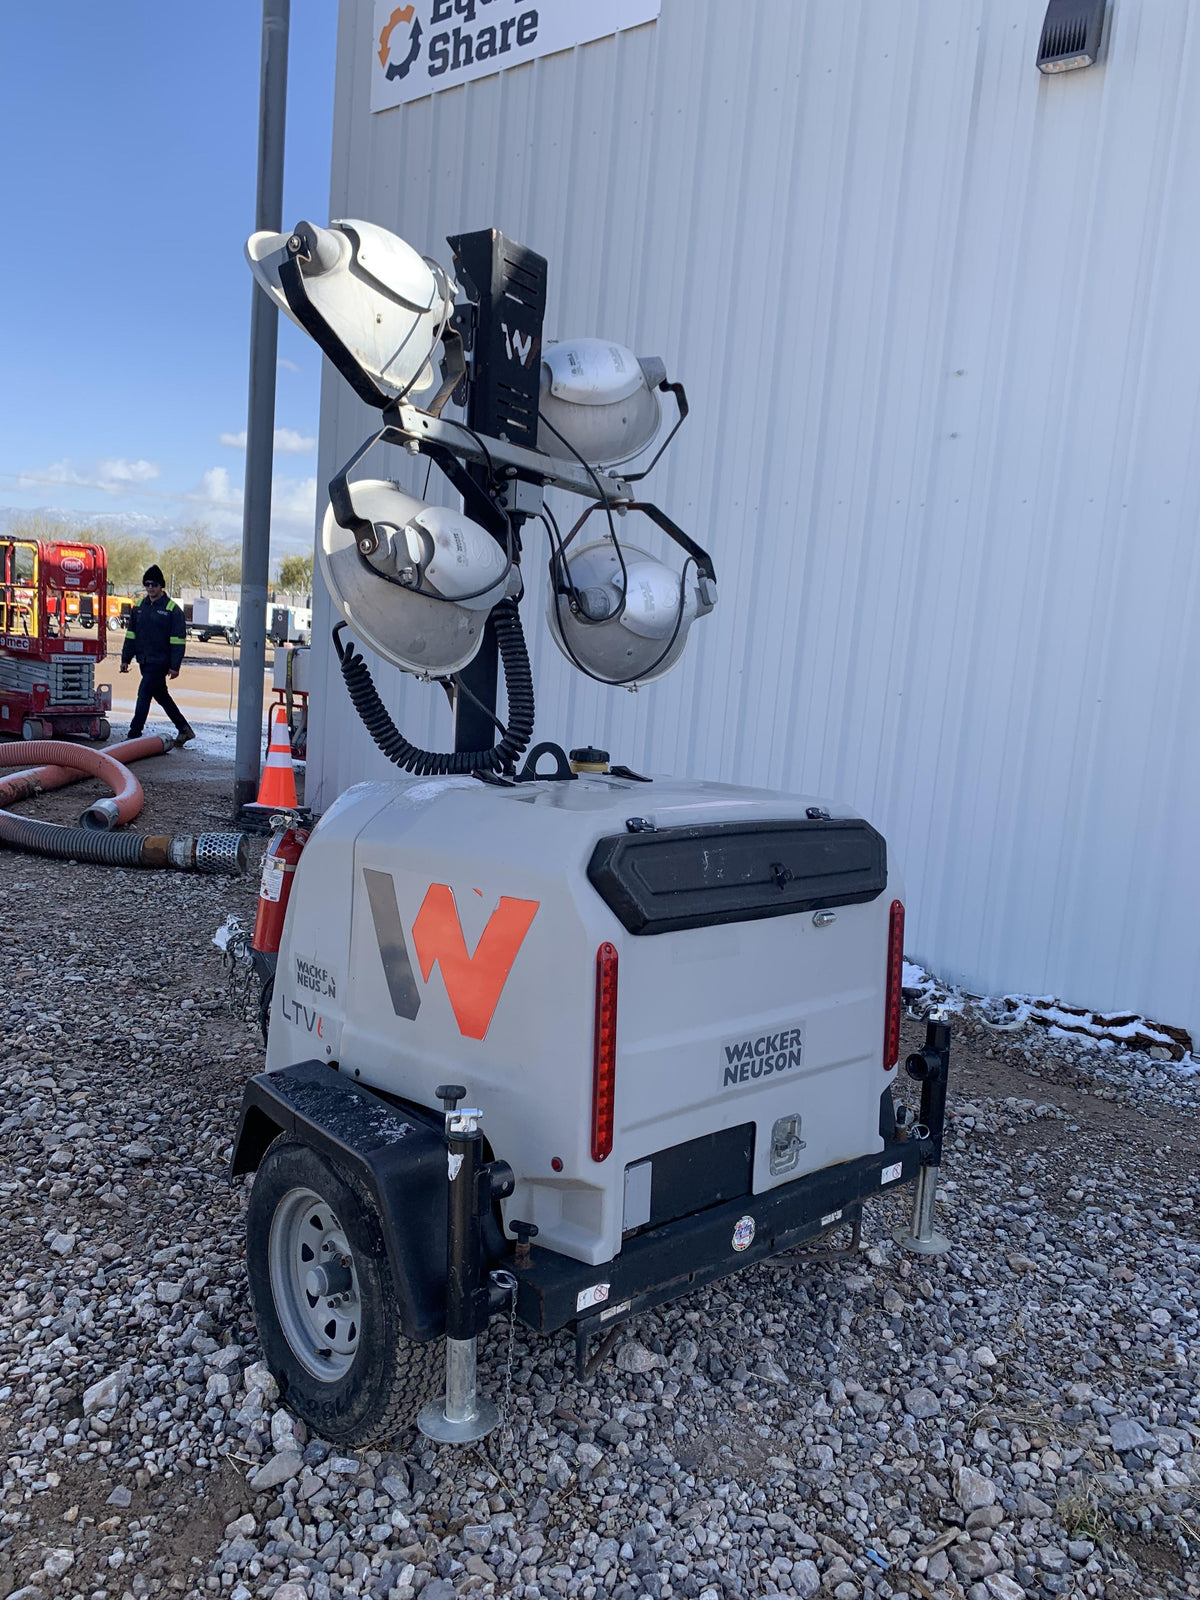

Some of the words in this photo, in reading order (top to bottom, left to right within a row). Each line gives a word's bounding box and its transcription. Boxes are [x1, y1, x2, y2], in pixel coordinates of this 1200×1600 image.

[428, 9, 538, 77] Share
[7, 638, 29, 649] mec
[297, 958, 336, 985] WACKE
[297, 972, 336, 999] NEUSN
[724, 1028, 802, 1065] WACKER
[723, 1047, 802, 1087] NEUSON
